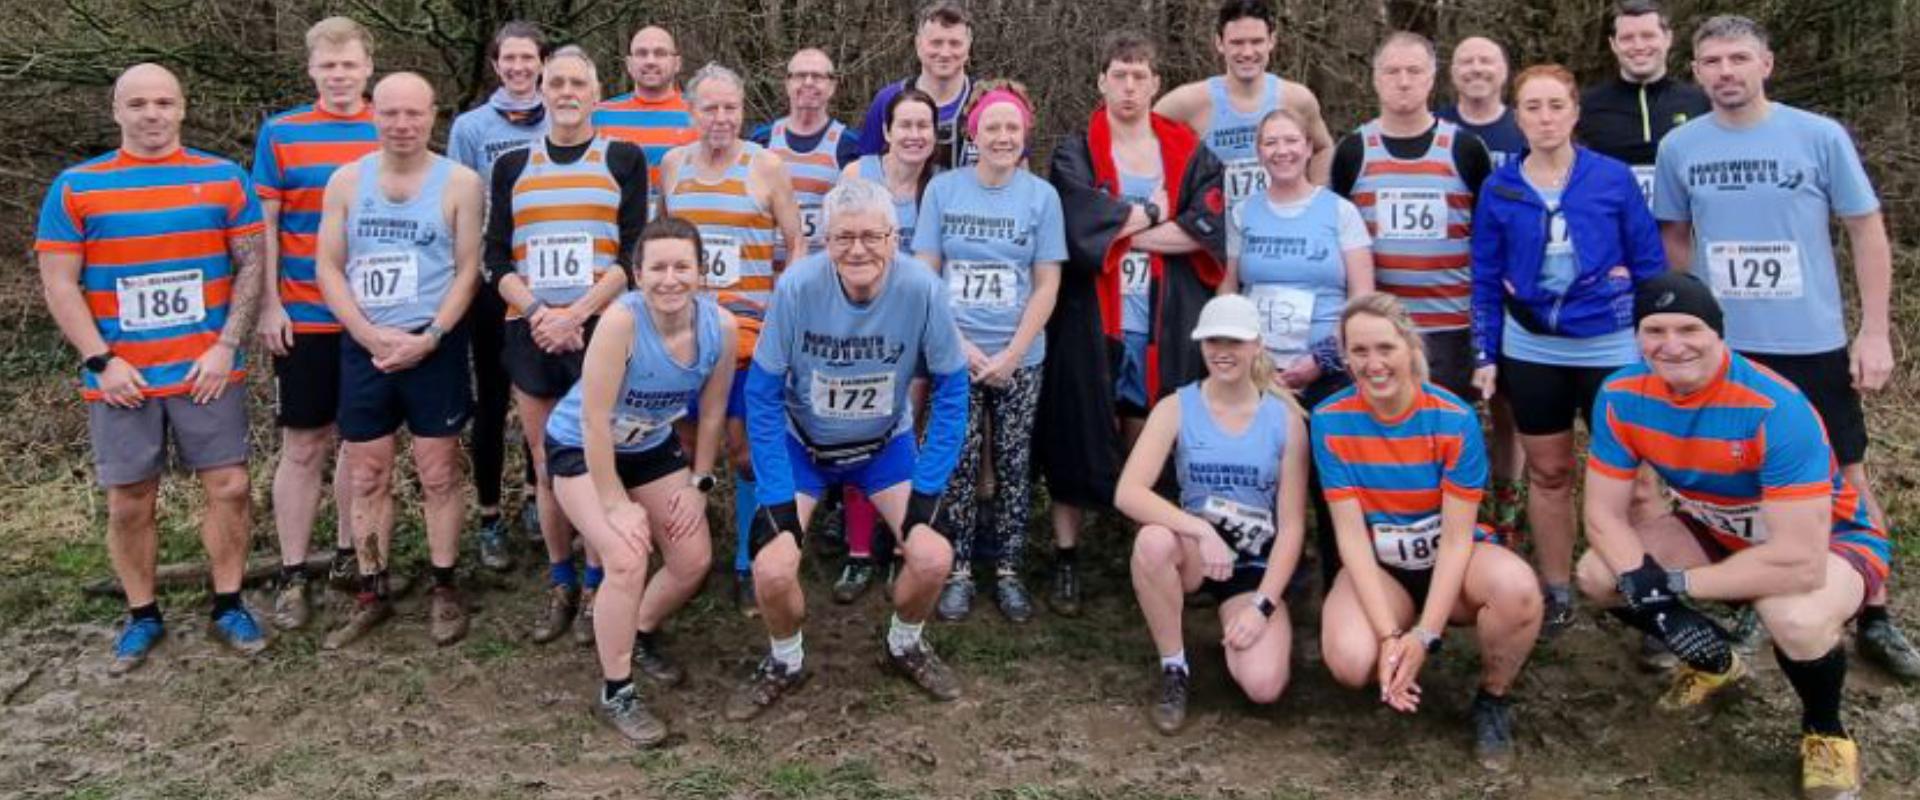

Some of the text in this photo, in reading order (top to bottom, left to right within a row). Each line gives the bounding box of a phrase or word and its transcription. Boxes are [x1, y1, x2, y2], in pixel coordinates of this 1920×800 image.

[1391, 203, 1434, 230] 156
[539, 249, 579, 277] 116
[1122, 258, 1150, 284] 97
[1729, 259, 1782, 288] 129
[363, 268, 401, 297] 107
[962, 273, 1002, 299] 174
[138, 287, 189, 318] 186
[829, 387, 877, 410] 172
